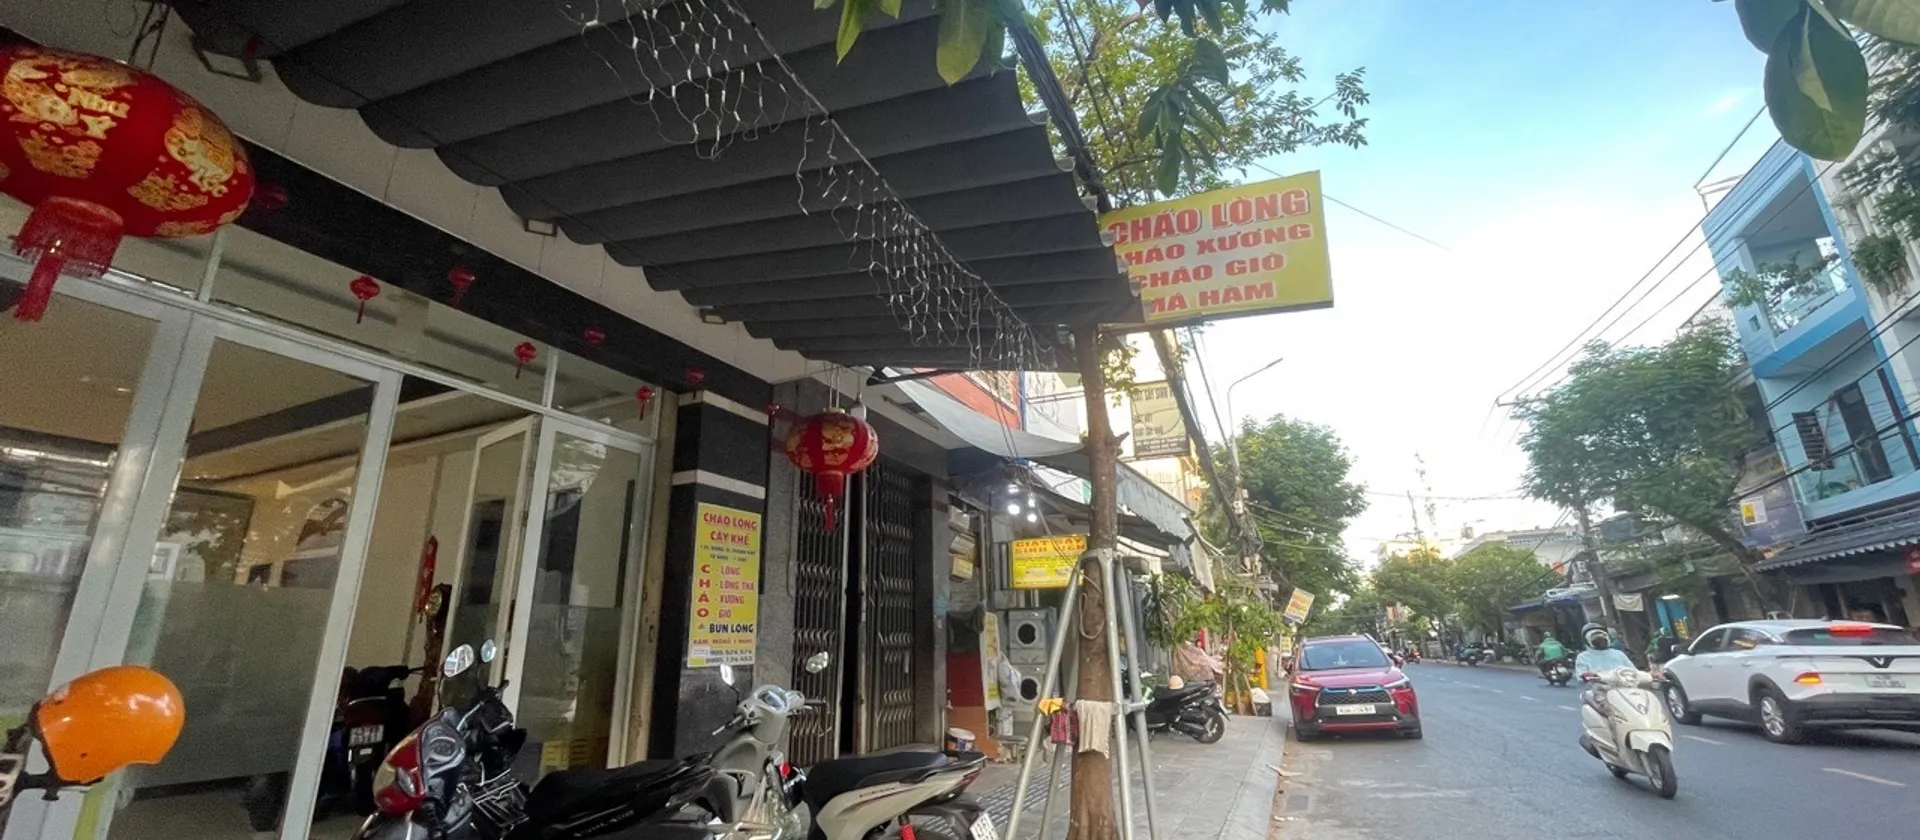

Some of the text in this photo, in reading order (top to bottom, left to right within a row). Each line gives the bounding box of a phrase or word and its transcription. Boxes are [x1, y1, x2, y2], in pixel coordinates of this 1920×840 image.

[1107, 188, 1310, 247] CHÁO LÒNG
[1119, 223, 1311, 267] HÁO XƯƠNG
[1225, 252, 1285, 277] GIÒ
[1198, 281, 1275, 307] HÀM
